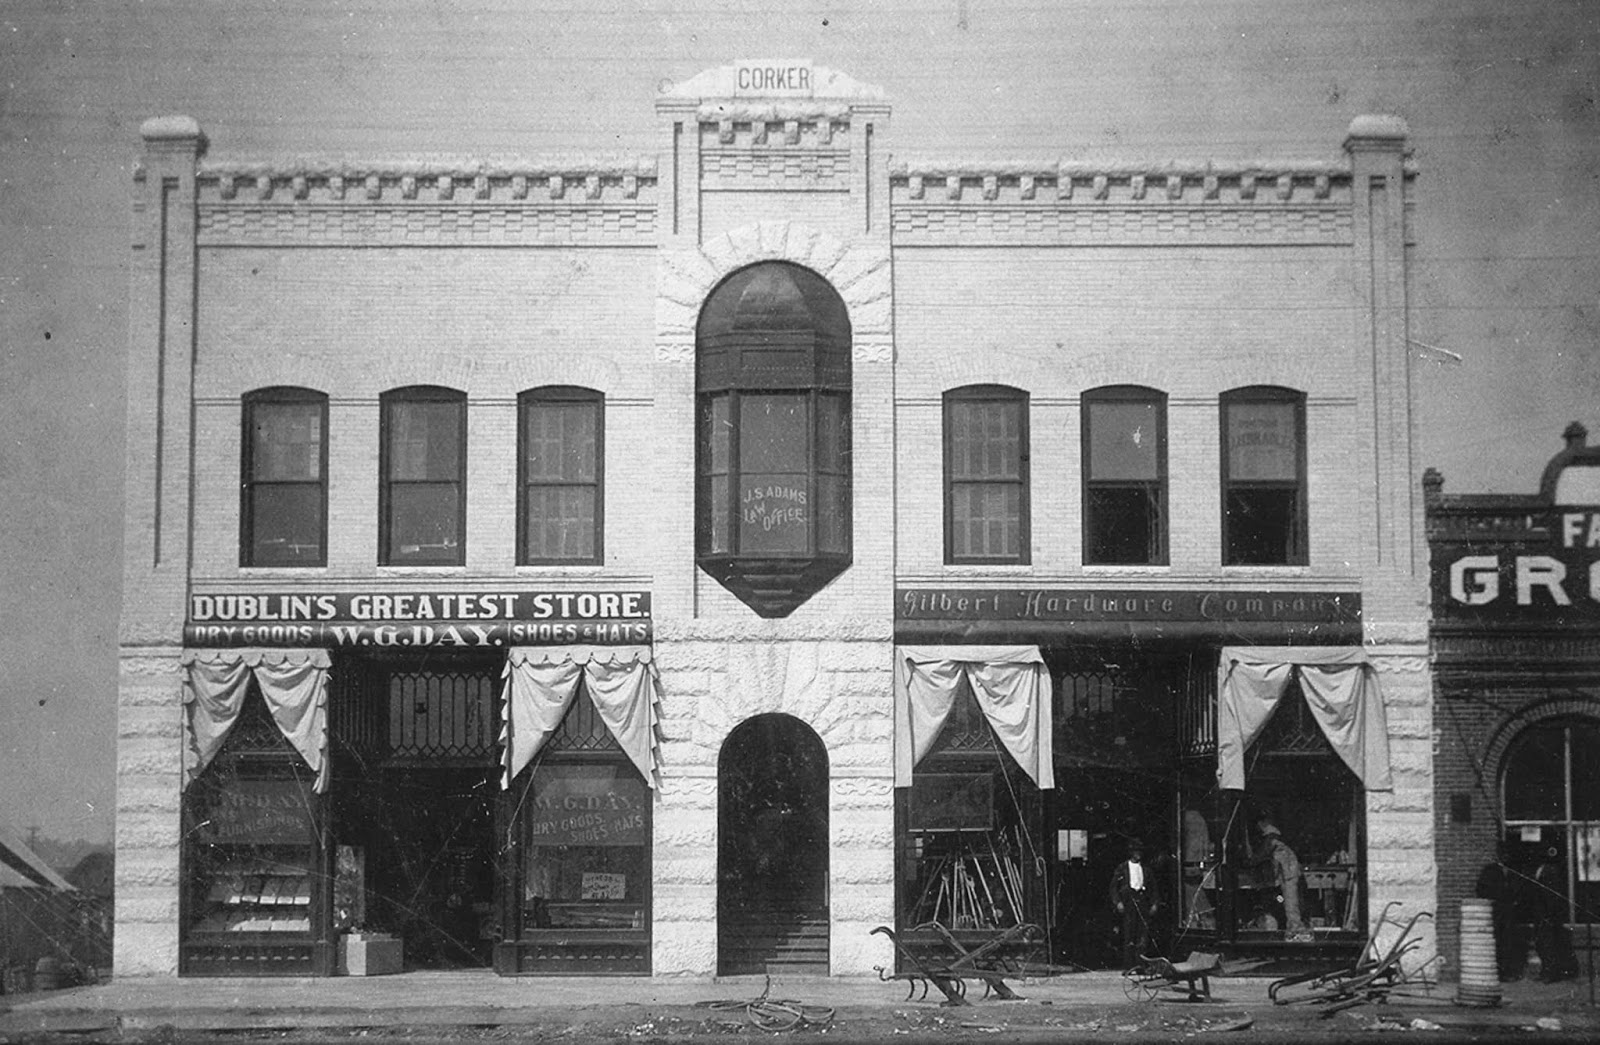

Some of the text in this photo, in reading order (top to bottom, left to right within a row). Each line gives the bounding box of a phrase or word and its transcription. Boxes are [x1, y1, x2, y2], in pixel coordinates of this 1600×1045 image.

[738, 67, 810, 90] CORKER
[744, 502, 766, 524] LAW
[1451, 555, 1600, 605] GR
[193, 593, 650, 620] DUBLIN'S GREATEST STORE.
[902, 590, 1000, 617] Gilbert
[1016, 590, 1173, 617] Hardware
[195, 625, 313, 643] DRY GOODS
[513, 624, 578, 642] SHOES
[571, 825, 608, 842] SHOES
